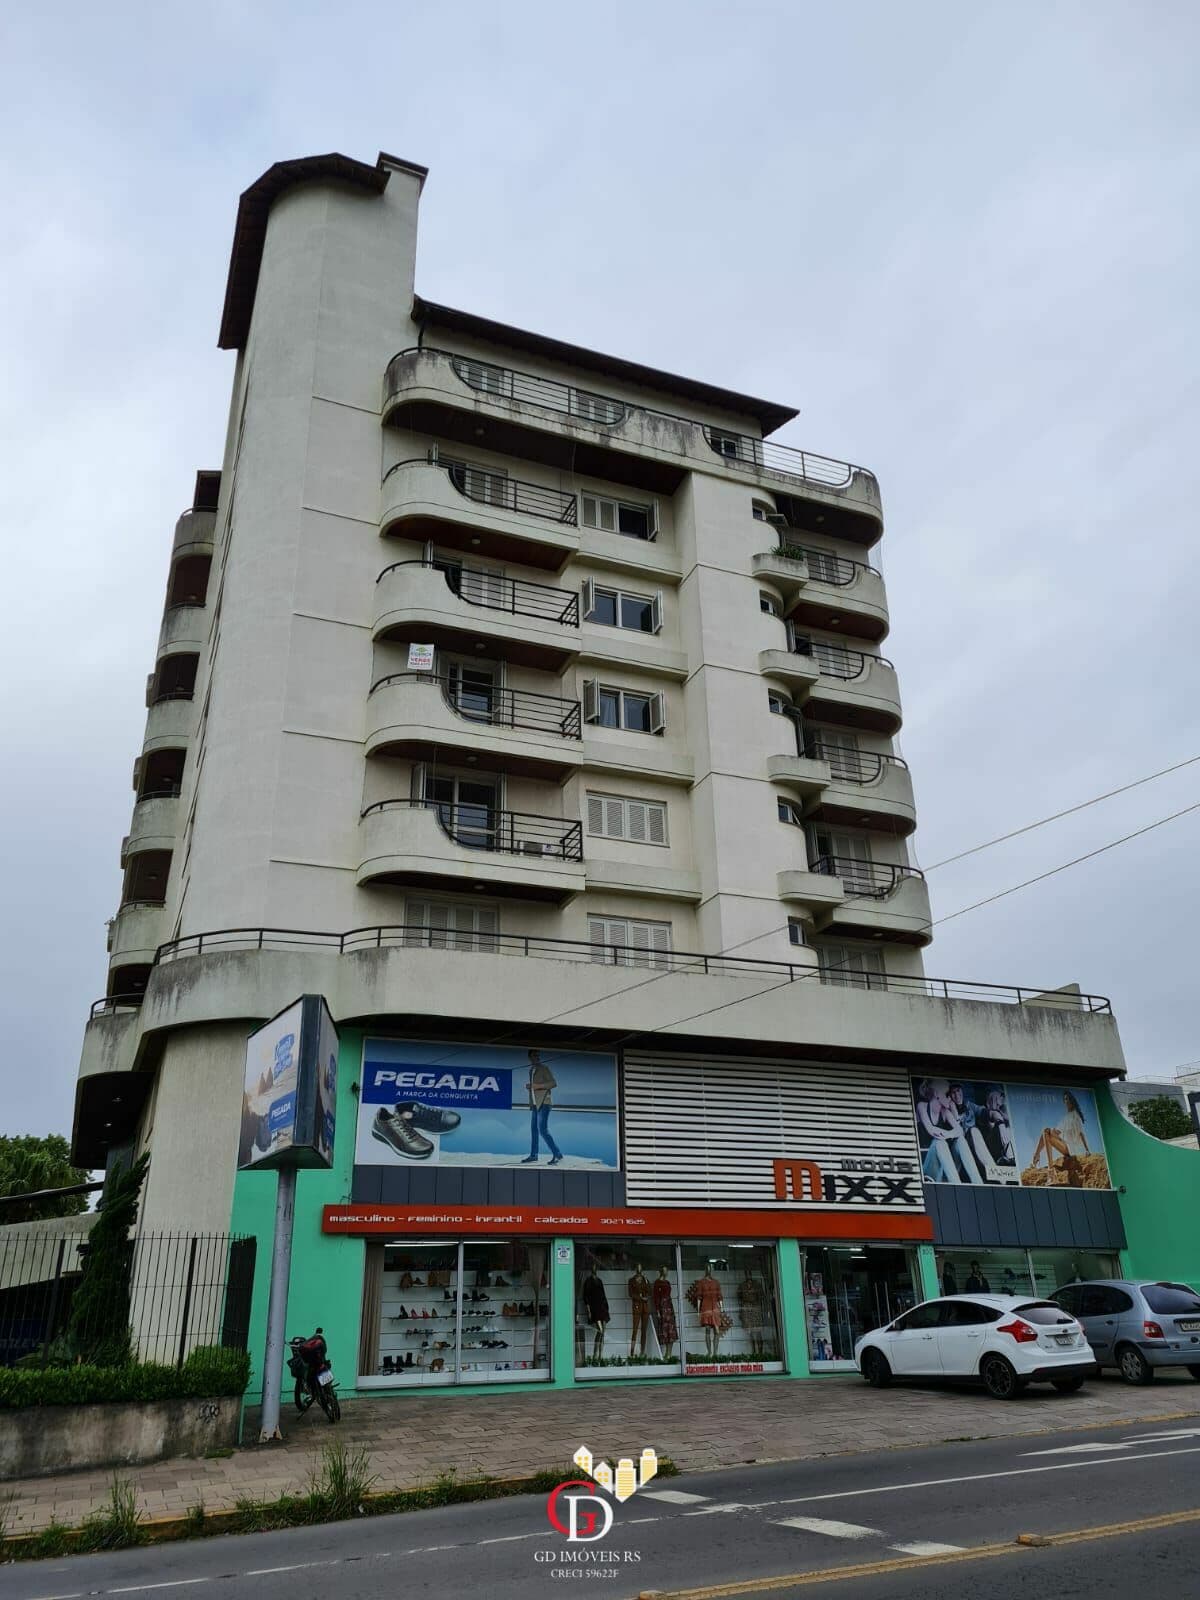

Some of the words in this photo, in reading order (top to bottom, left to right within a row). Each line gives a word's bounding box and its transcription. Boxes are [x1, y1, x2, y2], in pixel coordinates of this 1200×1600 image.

[374, 1070, 501, 1092] PEGADA
[402, 1090, 426, 1098] MARCA
[440, 1092, 478, 1100] CONQUISTA
[841, 1157, 914, 1172] moda
[329, 1214, 395, 1223] masculino
